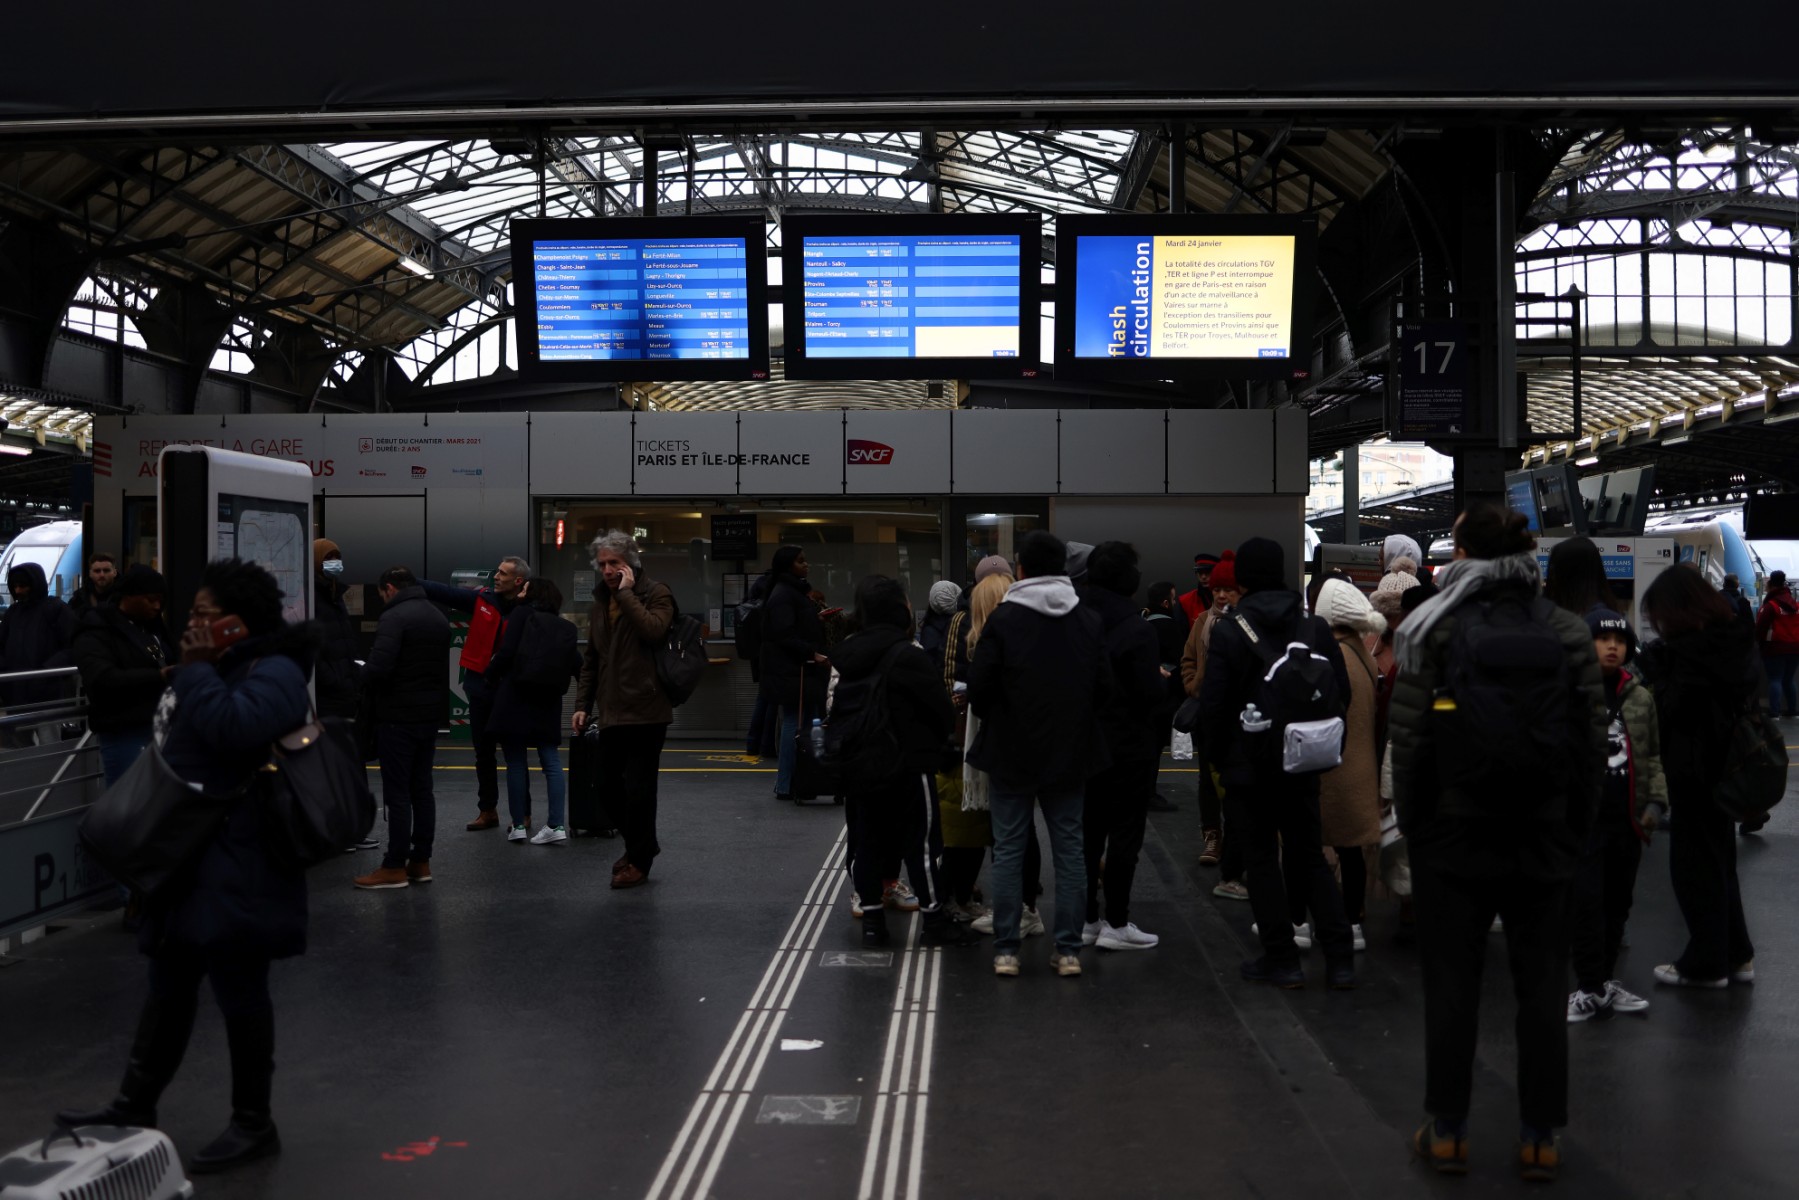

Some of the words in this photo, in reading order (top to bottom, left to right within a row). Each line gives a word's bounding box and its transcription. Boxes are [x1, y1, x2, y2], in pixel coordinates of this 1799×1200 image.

[1197, 240, 1222, 248] janvier
[1192, 271, 1208, 279] ligne
[1130, 242, 1150, 357] circulation
[1108, 306, 1126, 357] flash
[1208, 332, 1233, 340] Troyes,
[1414, 342, 1456, 374] 17
[251, 440, 303, 456] GARE
[637, 440, 690, 452] TICKETS
[638, 455, 677, 466] PARIS
[682, 455, 698, 465] ET
[703, 452, 810, 465] ÎLE-DE-FRANCE
[850, 449, 890, 461] SNCF
